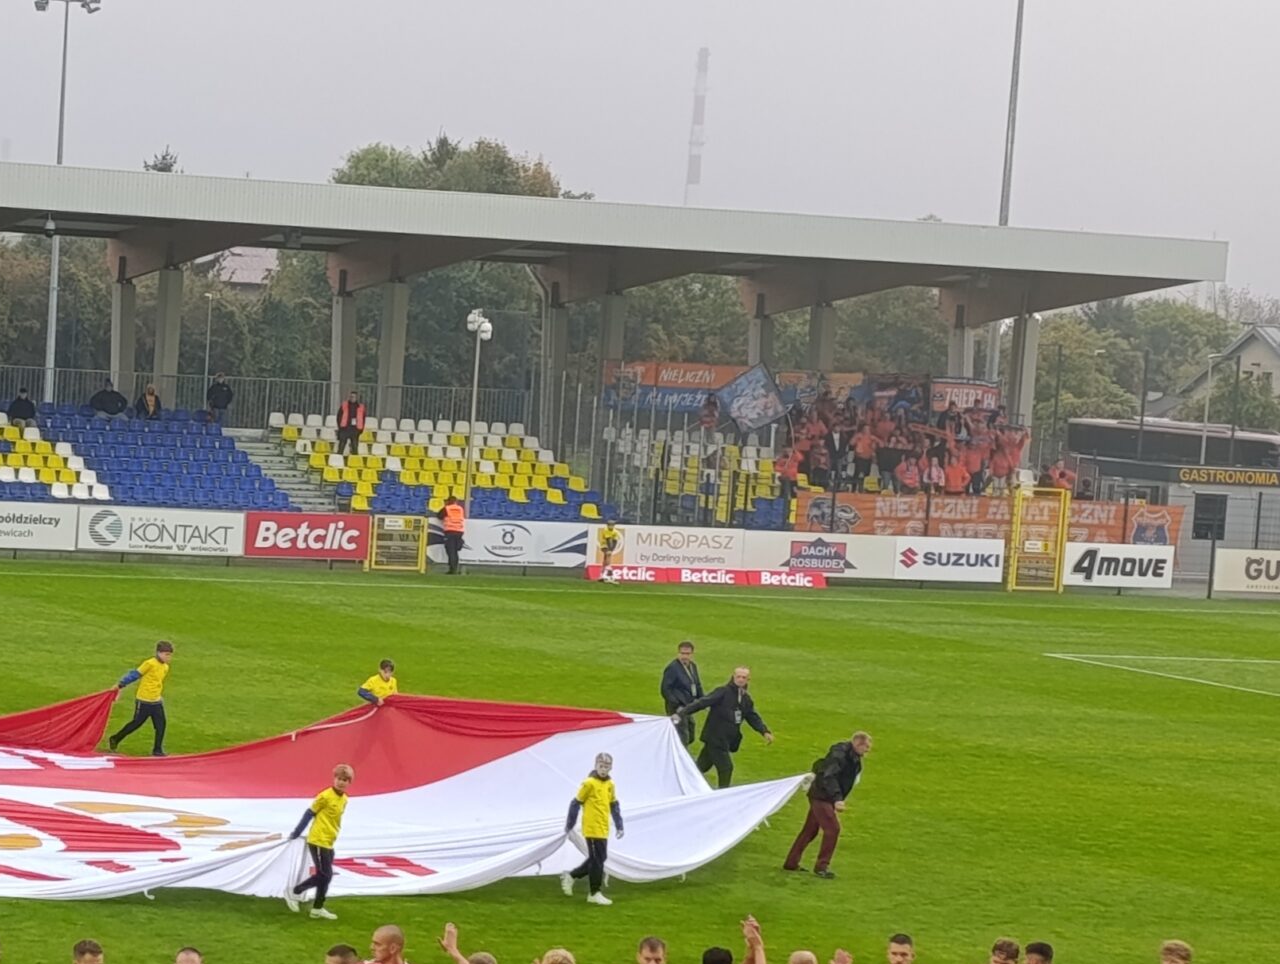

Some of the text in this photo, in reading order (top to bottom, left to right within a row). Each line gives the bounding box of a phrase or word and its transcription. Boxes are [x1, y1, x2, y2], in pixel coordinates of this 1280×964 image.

[1179, 468, 1280, 486] GASTRONOMIA
[874, 498, 978, 519] NIELCZNI
[129, 523, 235, 546] KONTAKT
[254, 521, 361, 551] Betclic
[640, 554, 651, 563] by
[652, 553, 681, 564] Darling
[802, 545, 837, 557] DACHY
[790, 556, 845, 569] ROSBUDEX
[923, 551, 1000, 568] SUZUKI
[681, 569, 735, 584] Betclic
[760, 571, 813, 587] Betclic
